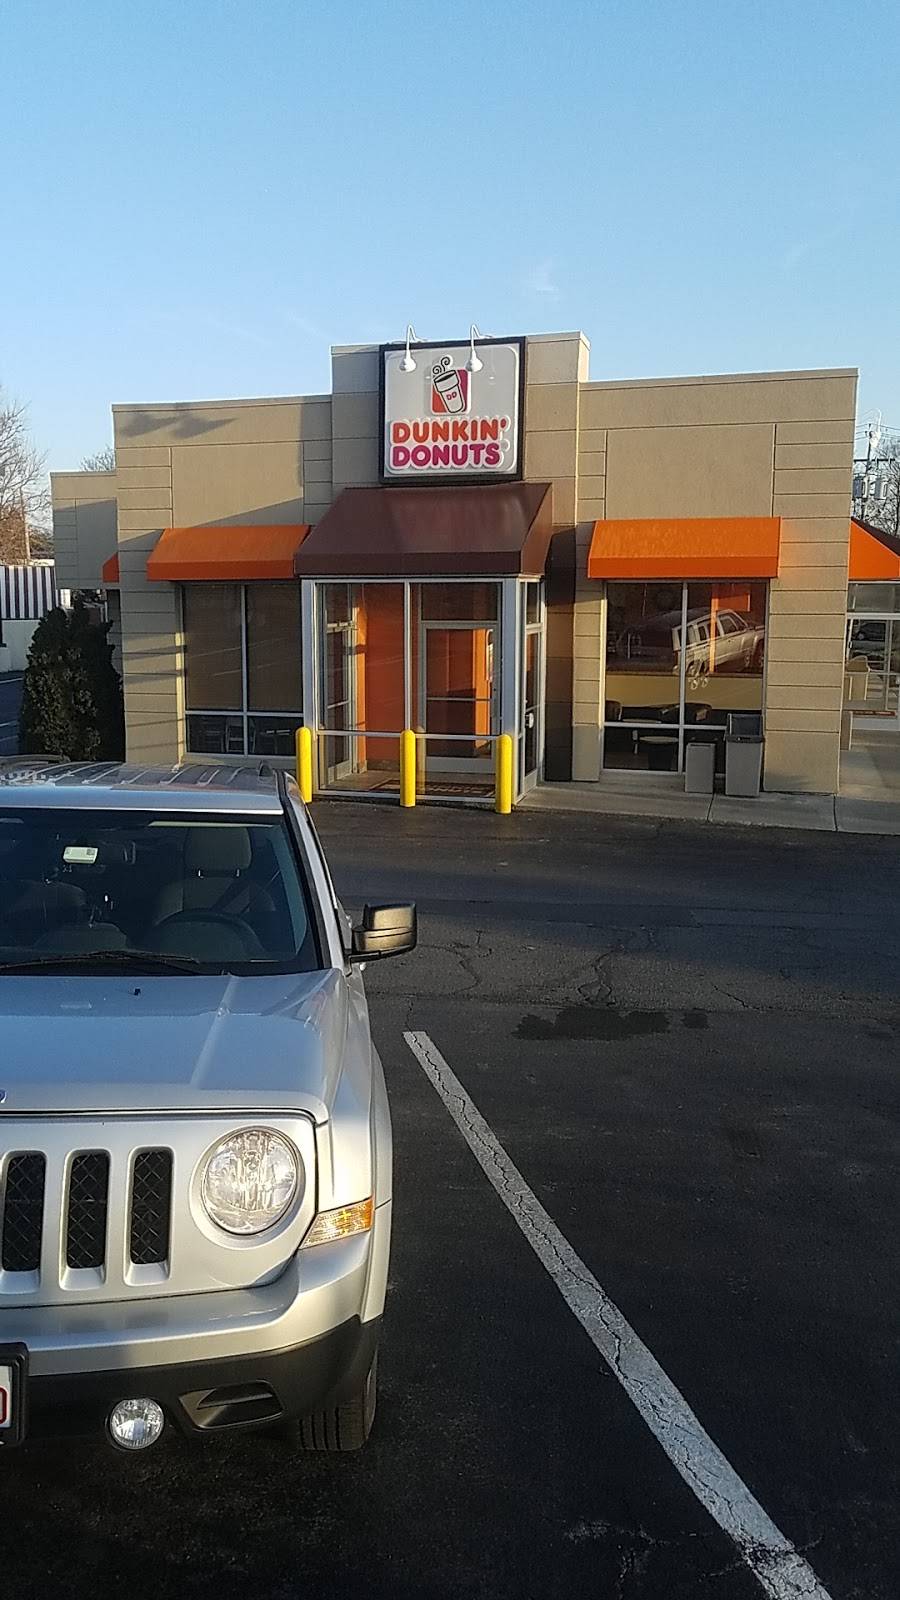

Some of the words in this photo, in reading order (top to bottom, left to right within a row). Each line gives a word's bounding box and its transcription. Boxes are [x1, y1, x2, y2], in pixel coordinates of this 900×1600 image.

[446, 391, 457, 401] DD
[392, 418, 507, 444] DUNKIN'
[392, 443, 500, 467] DONUTS
